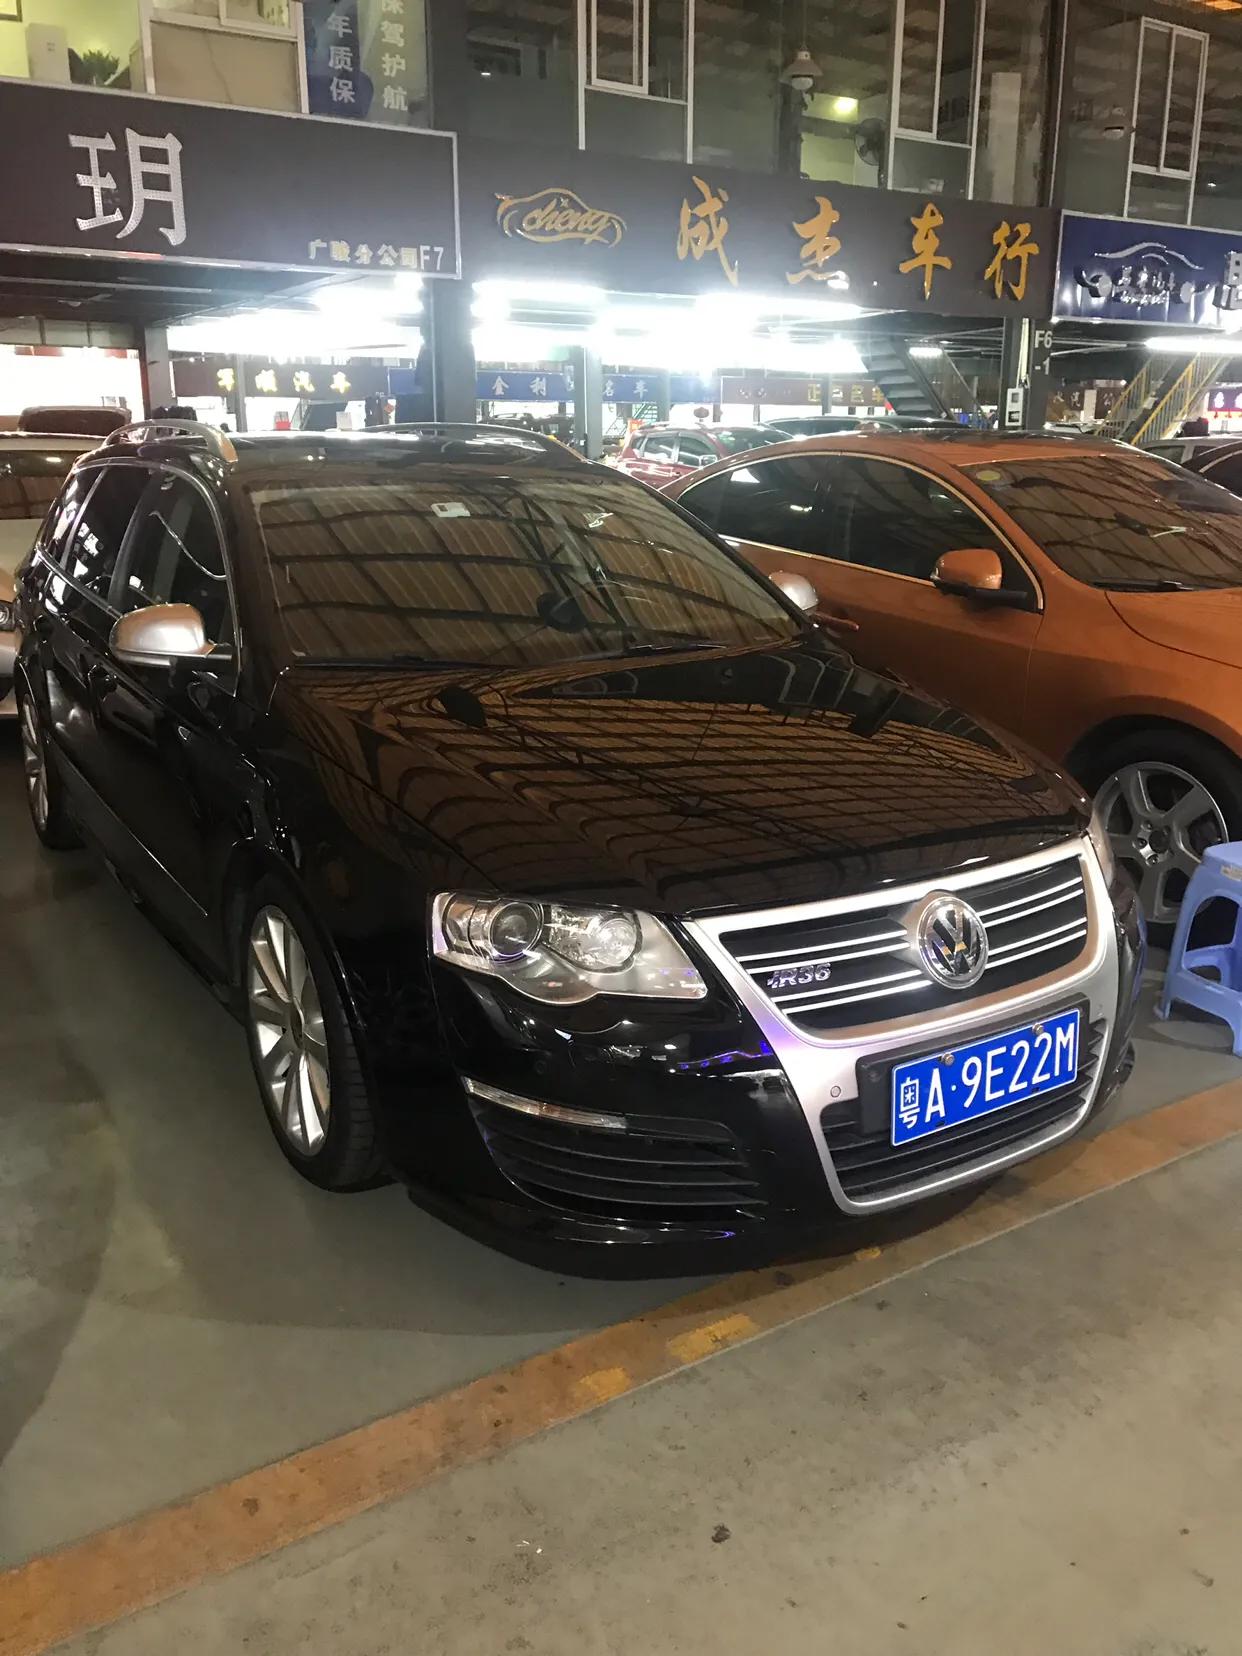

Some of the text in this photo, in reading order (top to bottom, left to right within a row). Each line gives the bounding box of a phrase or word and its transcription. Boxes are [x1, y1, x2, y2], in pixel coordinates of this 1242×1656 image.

[326, 12, 356, 103] 年质保
[68, 127, 187, 246] 玥
[1034, 330, 1053, 349] F6
